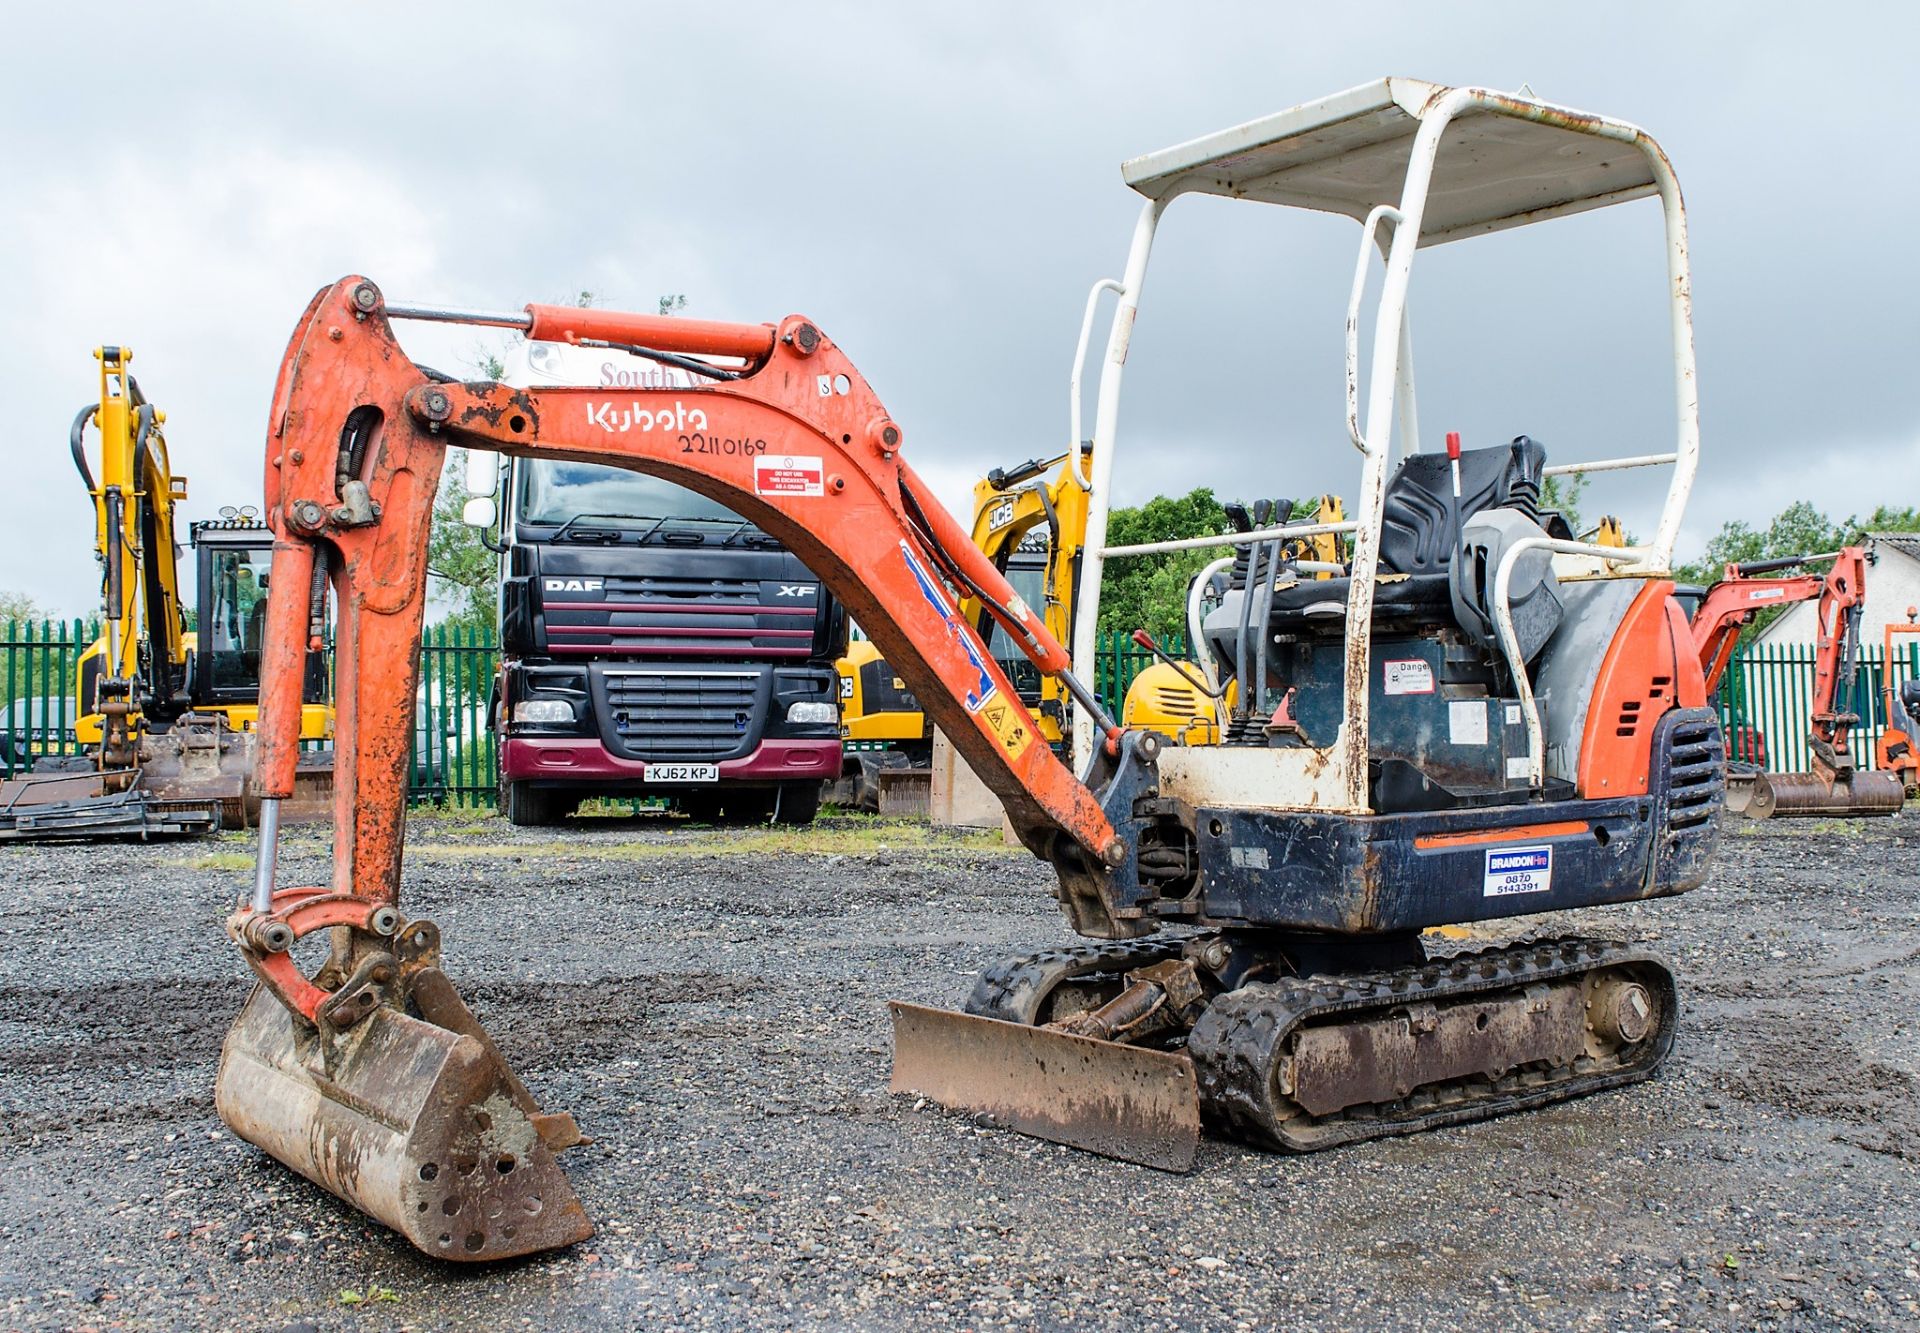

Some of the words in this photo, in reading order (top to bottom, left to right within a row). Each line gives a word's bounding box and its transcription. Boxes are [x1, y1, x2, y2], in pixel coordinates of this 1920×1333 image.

[600, 362, 675, 387] South
[586, 401, 707, 432] Kubota
[678, 433, 766, 456] 22110169
[989, 501, 1013, 530] JCB
[545, 580, 602, 592] DAF
[776, 585, 816, 597] XF
[653, 768, 687, 779] KJ62
[691, 768, 716, 779] KPJ
[1505, 873, 1531, 884] 0870
[1497, 883, 1538, 894] 5143391
